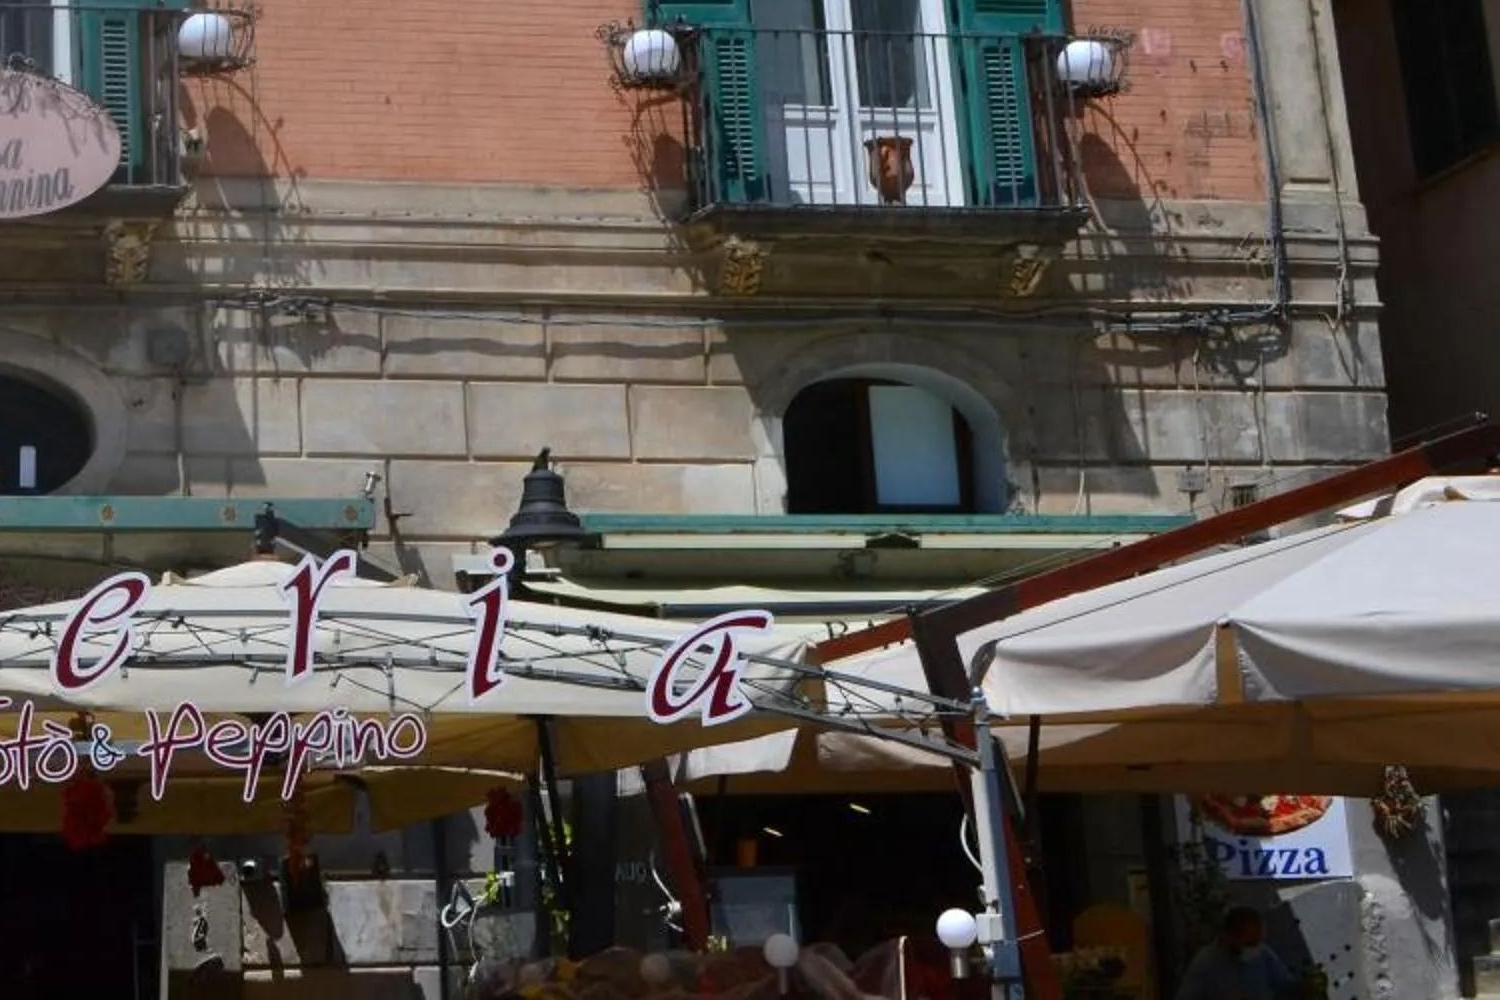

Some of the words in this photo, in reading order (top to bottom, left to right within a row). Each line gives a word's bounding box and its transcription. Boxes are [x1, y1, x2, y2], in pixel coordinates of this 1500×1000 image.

[89, 723, 125, 771] &
[137, 700, 428, 803] Peppino
[1206, 837, 1330, 877] Pizza
